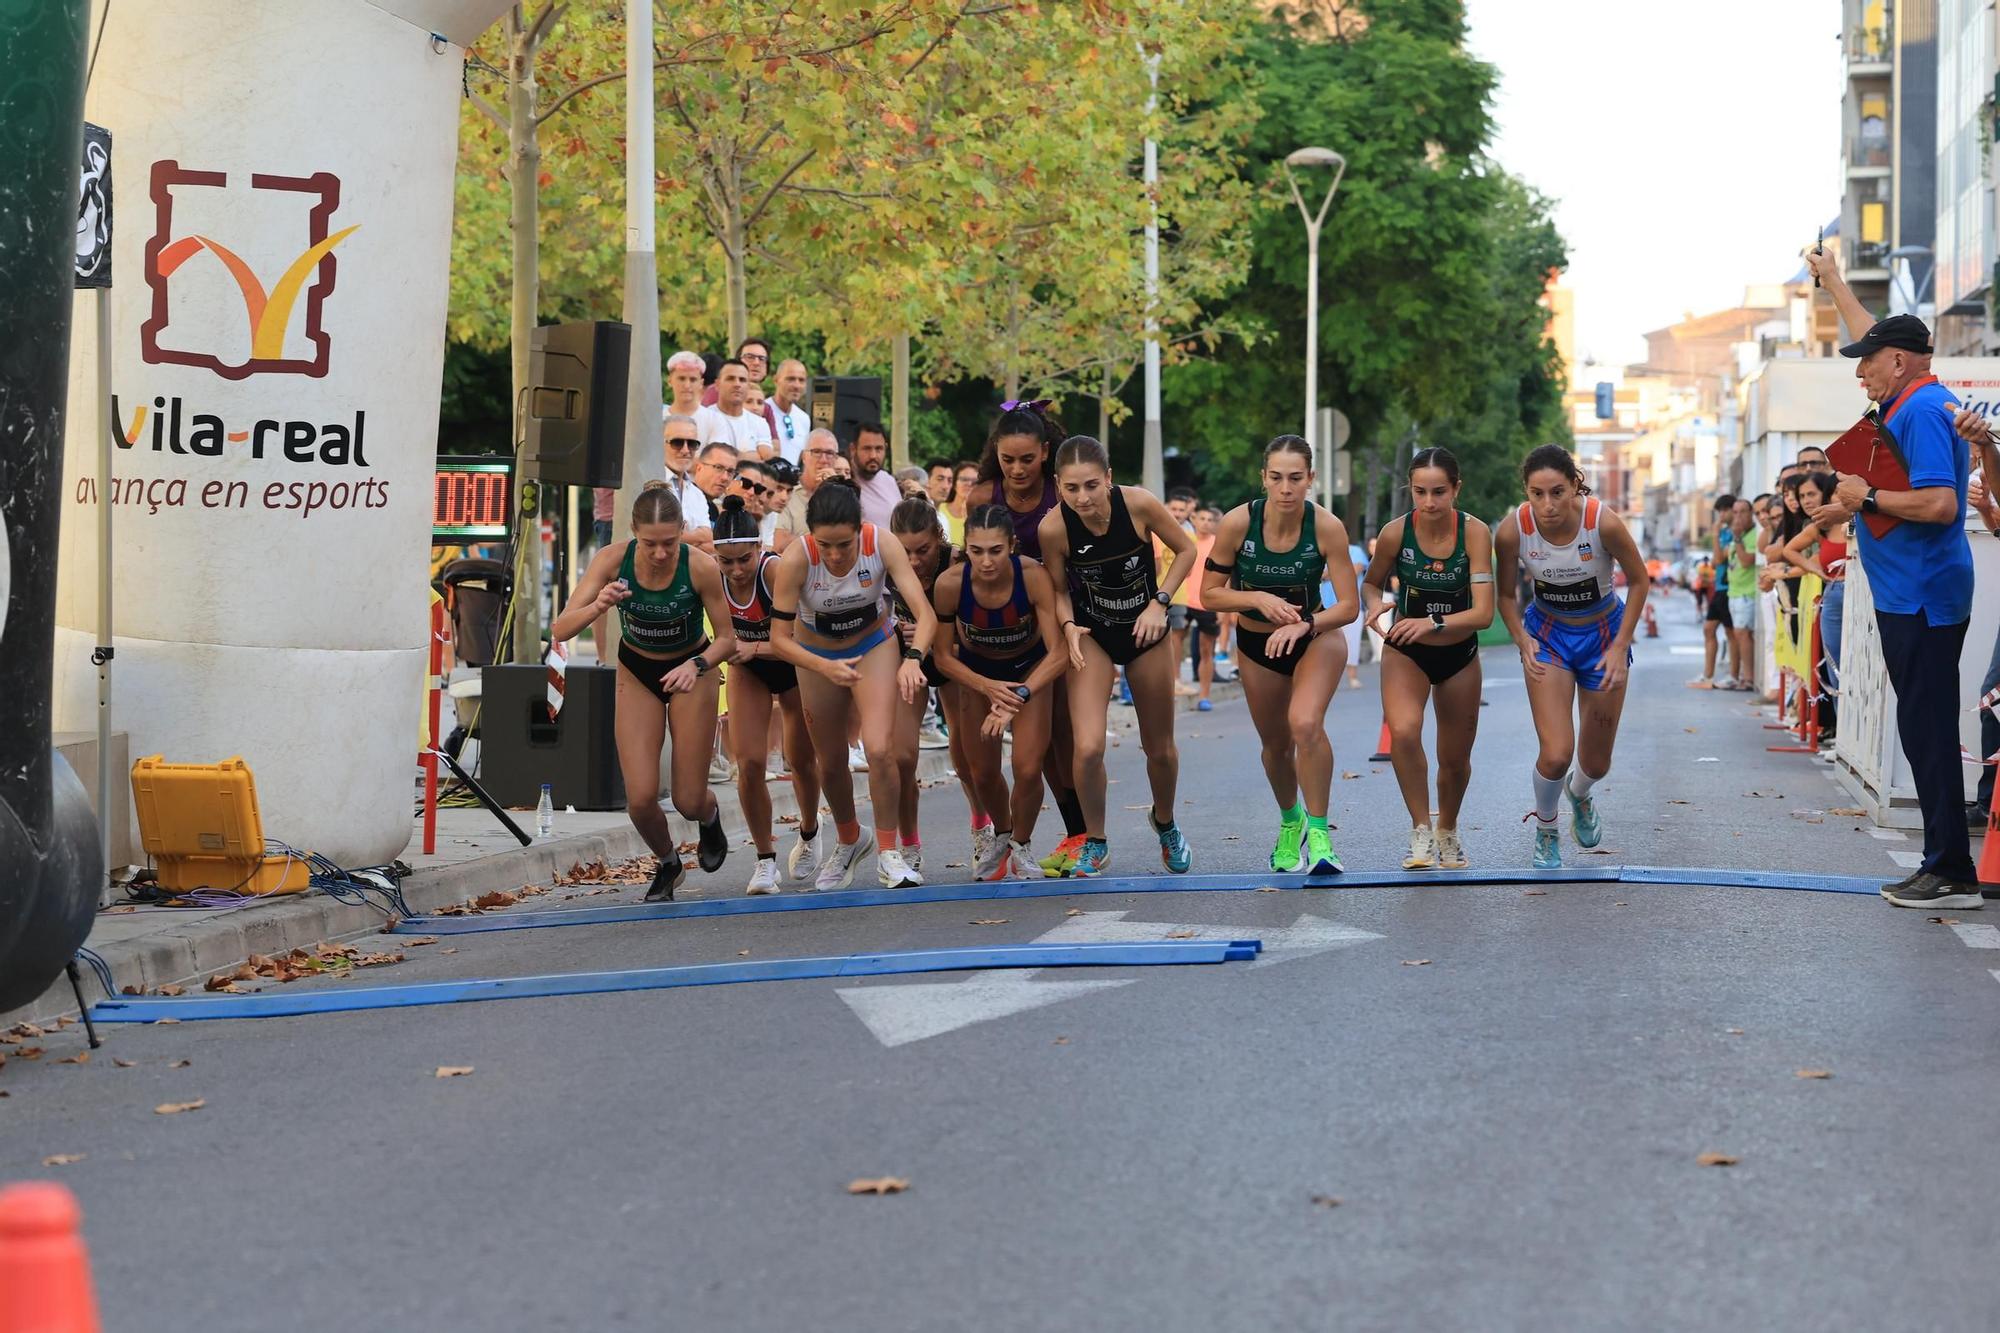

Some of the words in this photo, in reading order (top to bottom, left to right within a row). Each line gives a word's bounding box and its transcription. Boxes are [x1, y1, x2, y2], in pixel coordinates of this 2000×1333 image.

[112, 394, 370, 467] Vila-real
[201, 479, 249, 509] en
[263, 477, 390, 519] esports
[1093, 592, 1145, 611] FERNÁNDEZ
[1543, 591, 1593, 602] GONZÁLEZ
[1426, 603, 1452, 613] SOTO
[629, 623, 681, 637] RODRÍGUEZ
[831, 617, 863, 631] MASIP
